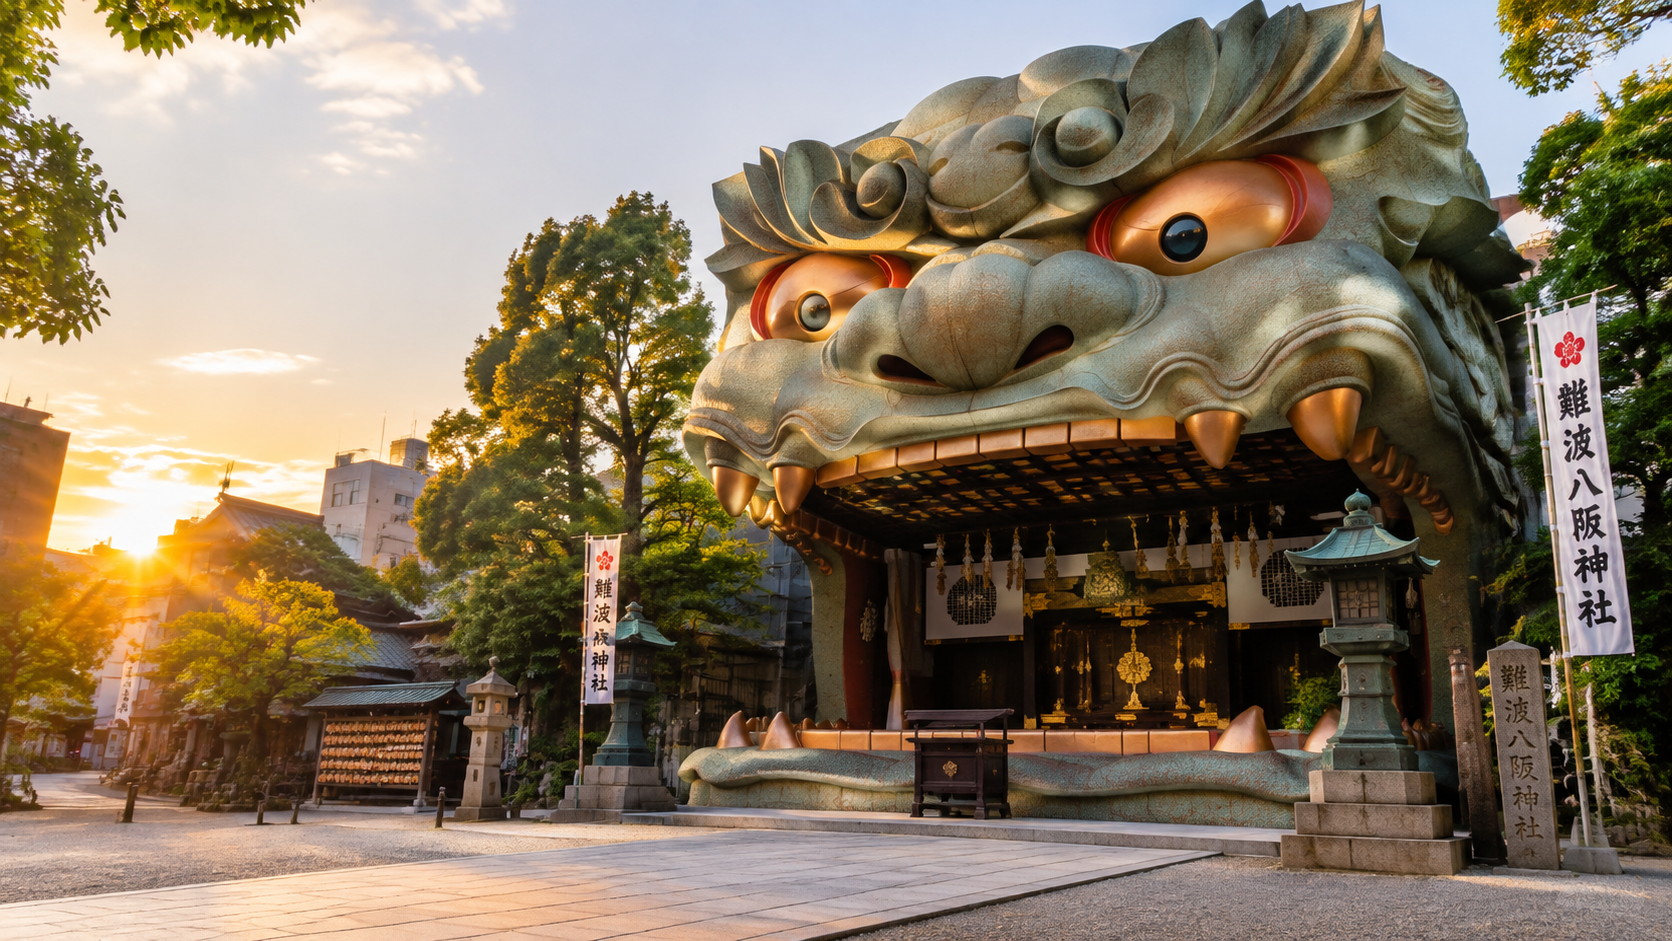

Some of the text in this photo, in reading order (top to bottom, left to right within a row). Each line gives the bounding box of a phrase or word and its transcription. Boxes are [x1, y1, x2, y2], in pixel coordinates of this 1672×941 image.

[1557, 378, 1617, 628] 難波八阪神社
[1500, 664, 1544, 841] 難波八阪神社
